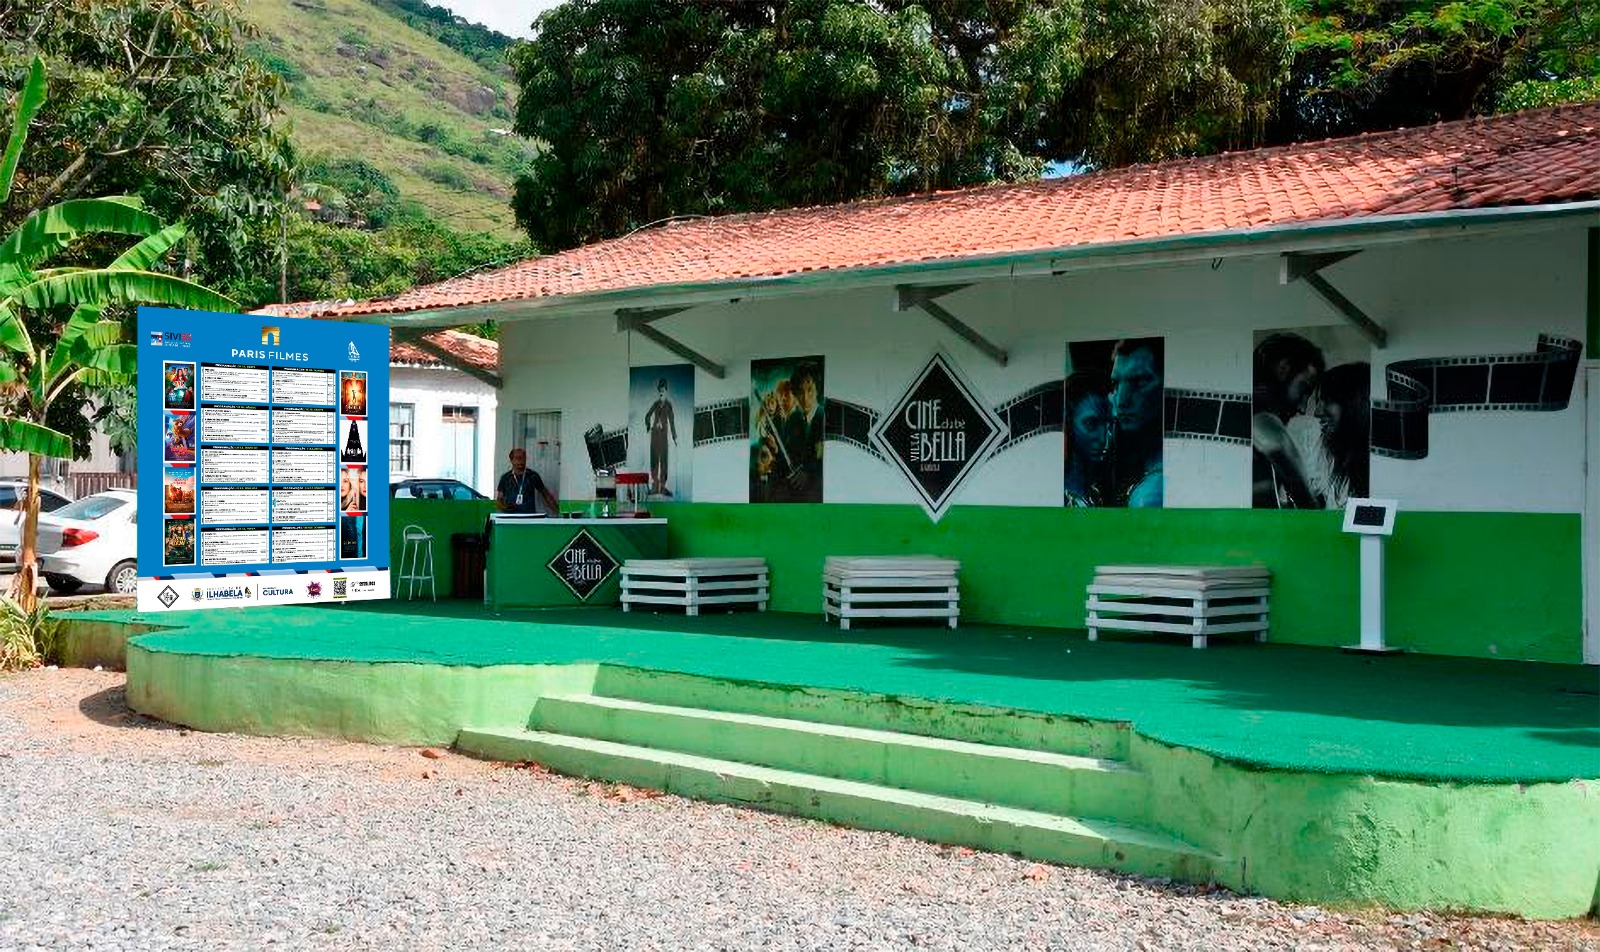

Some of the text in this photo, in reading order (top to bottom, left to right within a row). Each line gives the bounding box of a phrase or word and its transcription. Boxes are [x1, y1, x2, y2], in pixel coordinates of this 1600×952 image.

[231, 348, 309, 362] PARIS FILMES
[905, 399, 942, 430] CINE
[920, 431, 966, 462] BELLA
[564, 548, 586, 564] CINE
[206, 589, 243, 599] ILHABELA
[262, 588, 294, 596] CULTURA
